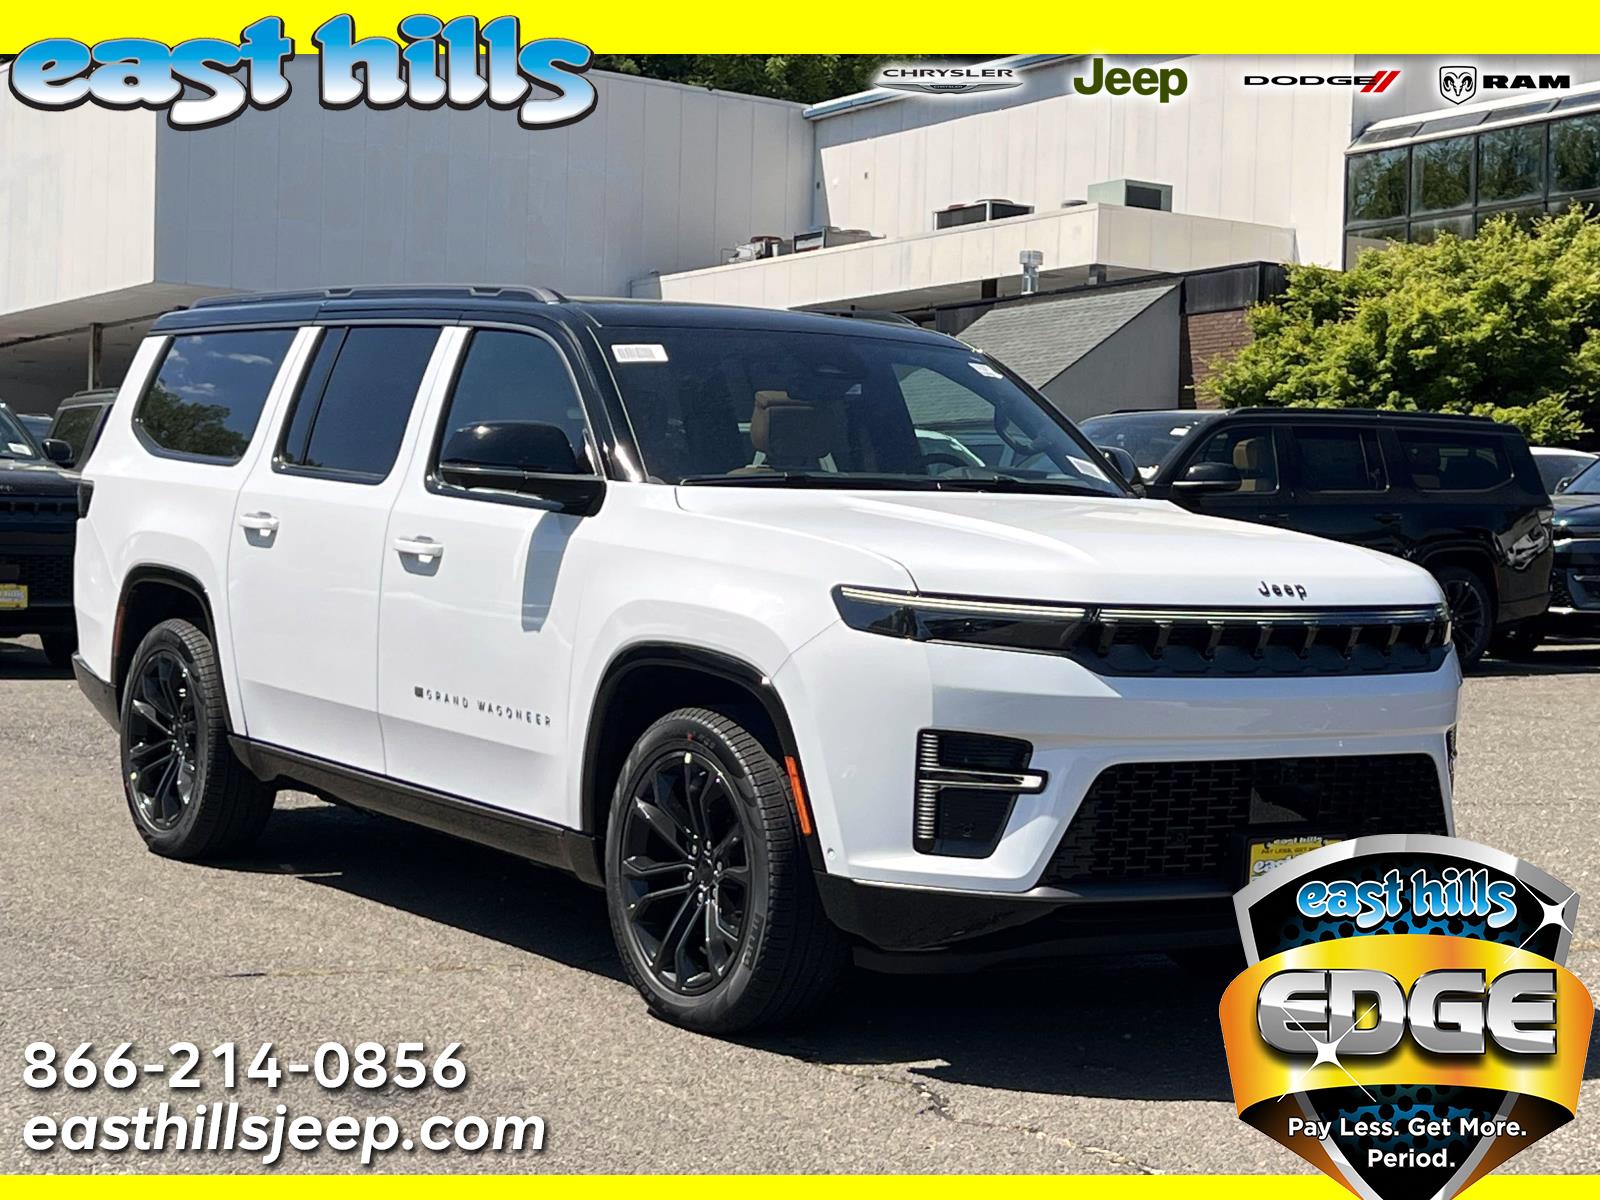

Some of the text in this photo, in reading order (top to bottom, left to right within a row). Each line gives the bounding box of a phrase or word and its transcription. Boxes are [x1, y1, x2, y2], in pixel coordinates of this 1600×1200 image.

[1257, 580, 1308, 602] Jeep
[426, 689, 552, 727] GRAND WAGONEER
